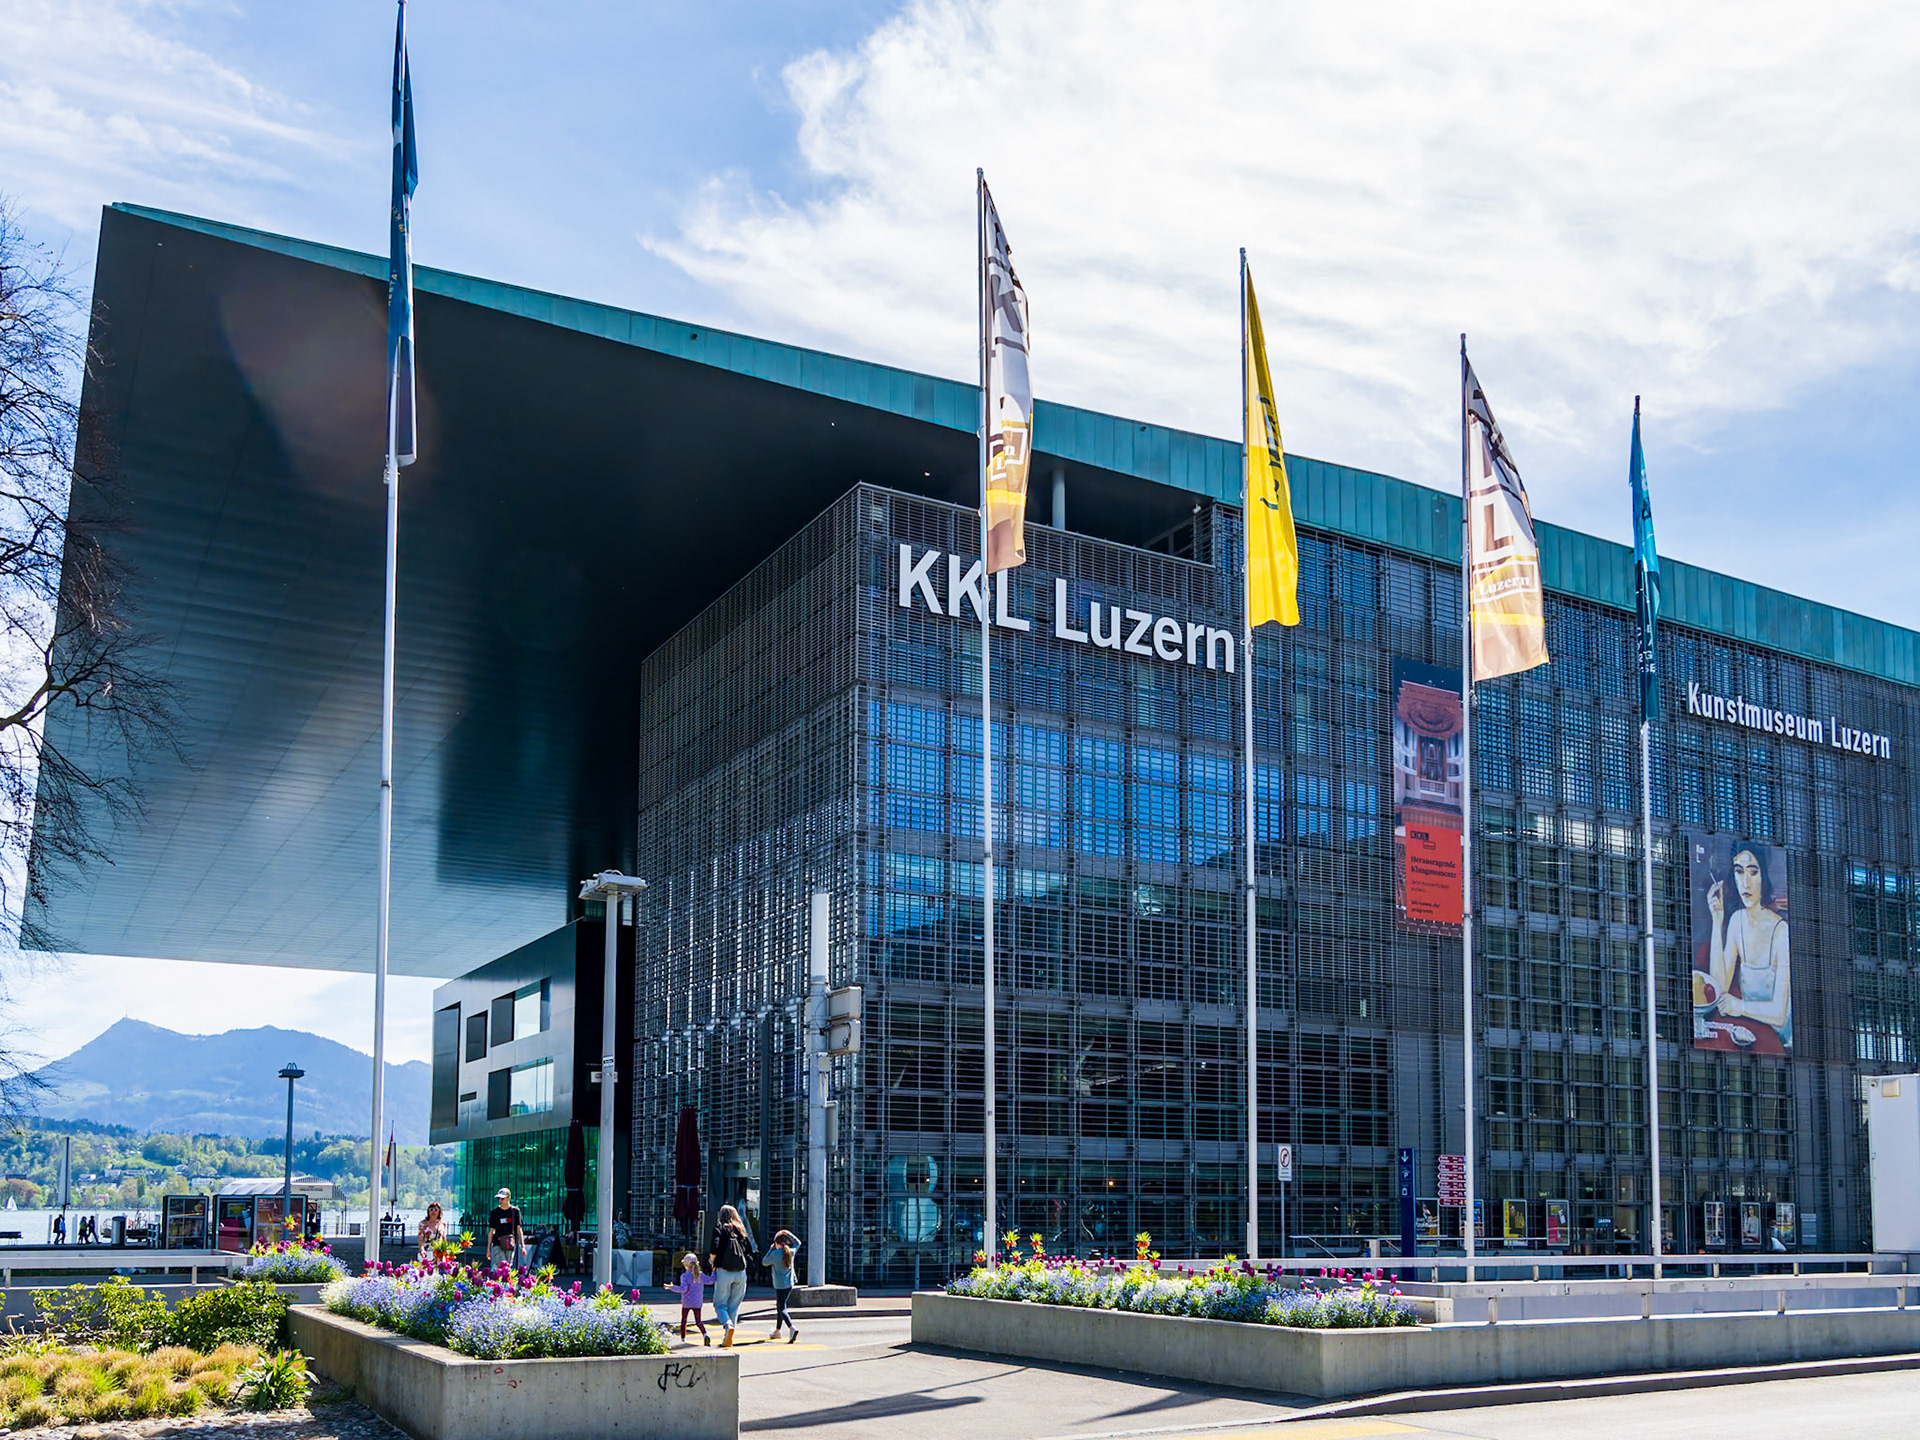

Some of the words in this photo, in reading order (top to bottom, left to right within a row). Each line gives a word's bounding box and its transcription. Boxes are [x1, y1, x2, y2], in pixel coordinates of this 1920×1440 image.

[899, 543, 1030, 632] KKL
[1055, 578, 1235, 674] Luzern
[1479, 576, 1530, 595] Luzern
[1688, 681, 1823, 744] Kunstmuseum
[1831, 716, 1891, 759] Luzern
